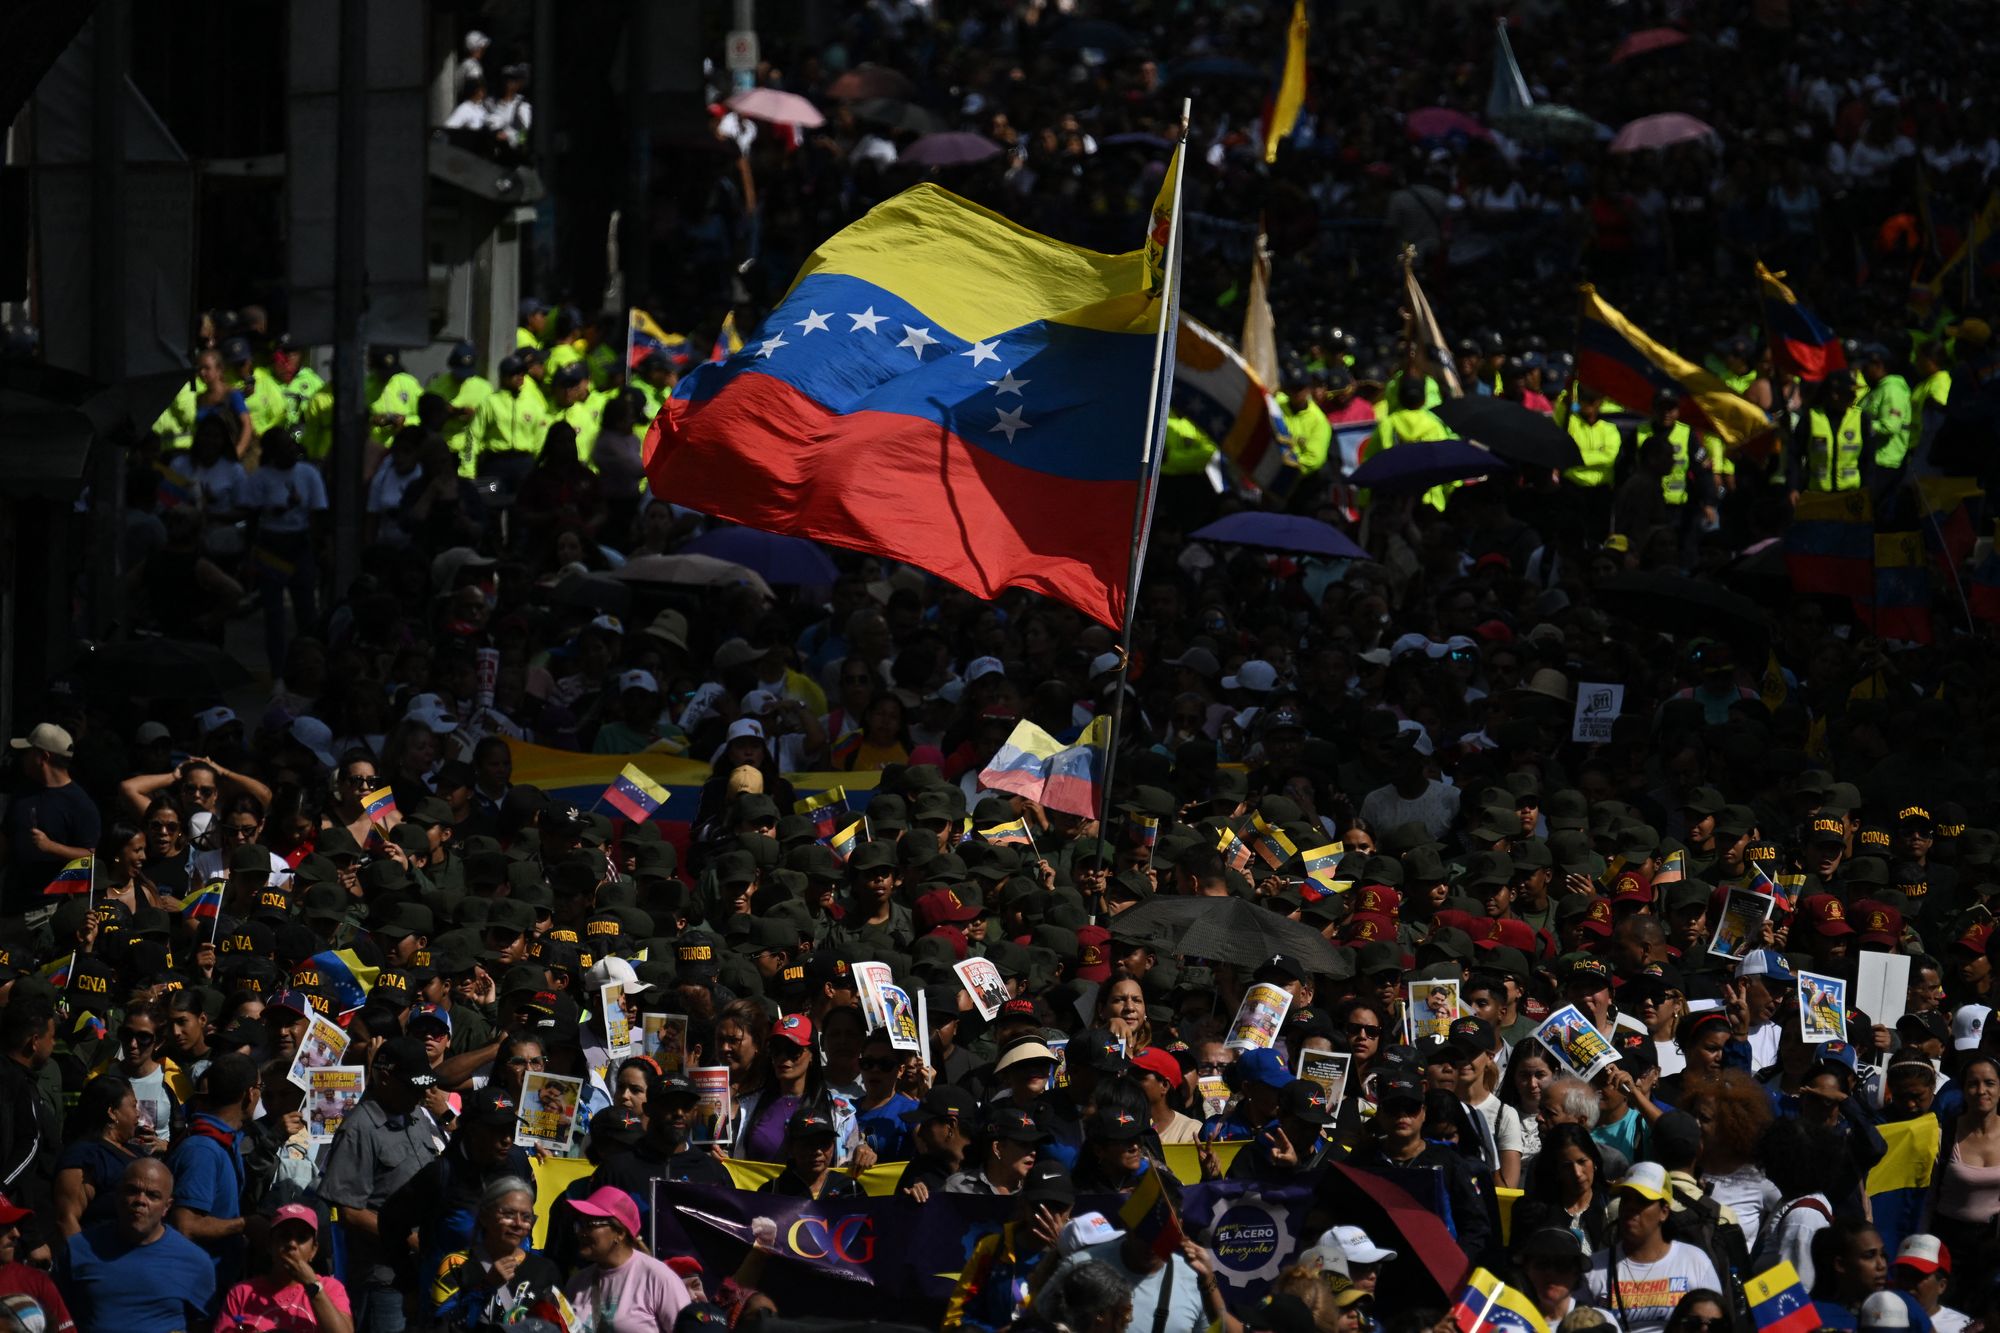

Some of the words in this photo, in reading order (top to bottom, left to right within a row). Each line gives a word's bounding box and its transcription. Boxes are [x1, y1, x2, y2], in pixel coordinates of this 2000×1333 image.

[1814, 819, 1843, 836] CONAS
[1861, 831, 1890, 847] CONAS
[261, 892, 287, 911] CNA
[77, 974, 108, 993] CNA
[292, 970, 320, 987] CNA
[377, 973, 408, 991] CNA
[1219, 1231, 1232, 1242] EL
[1233, 1228, 1274, 1240] ACERO
